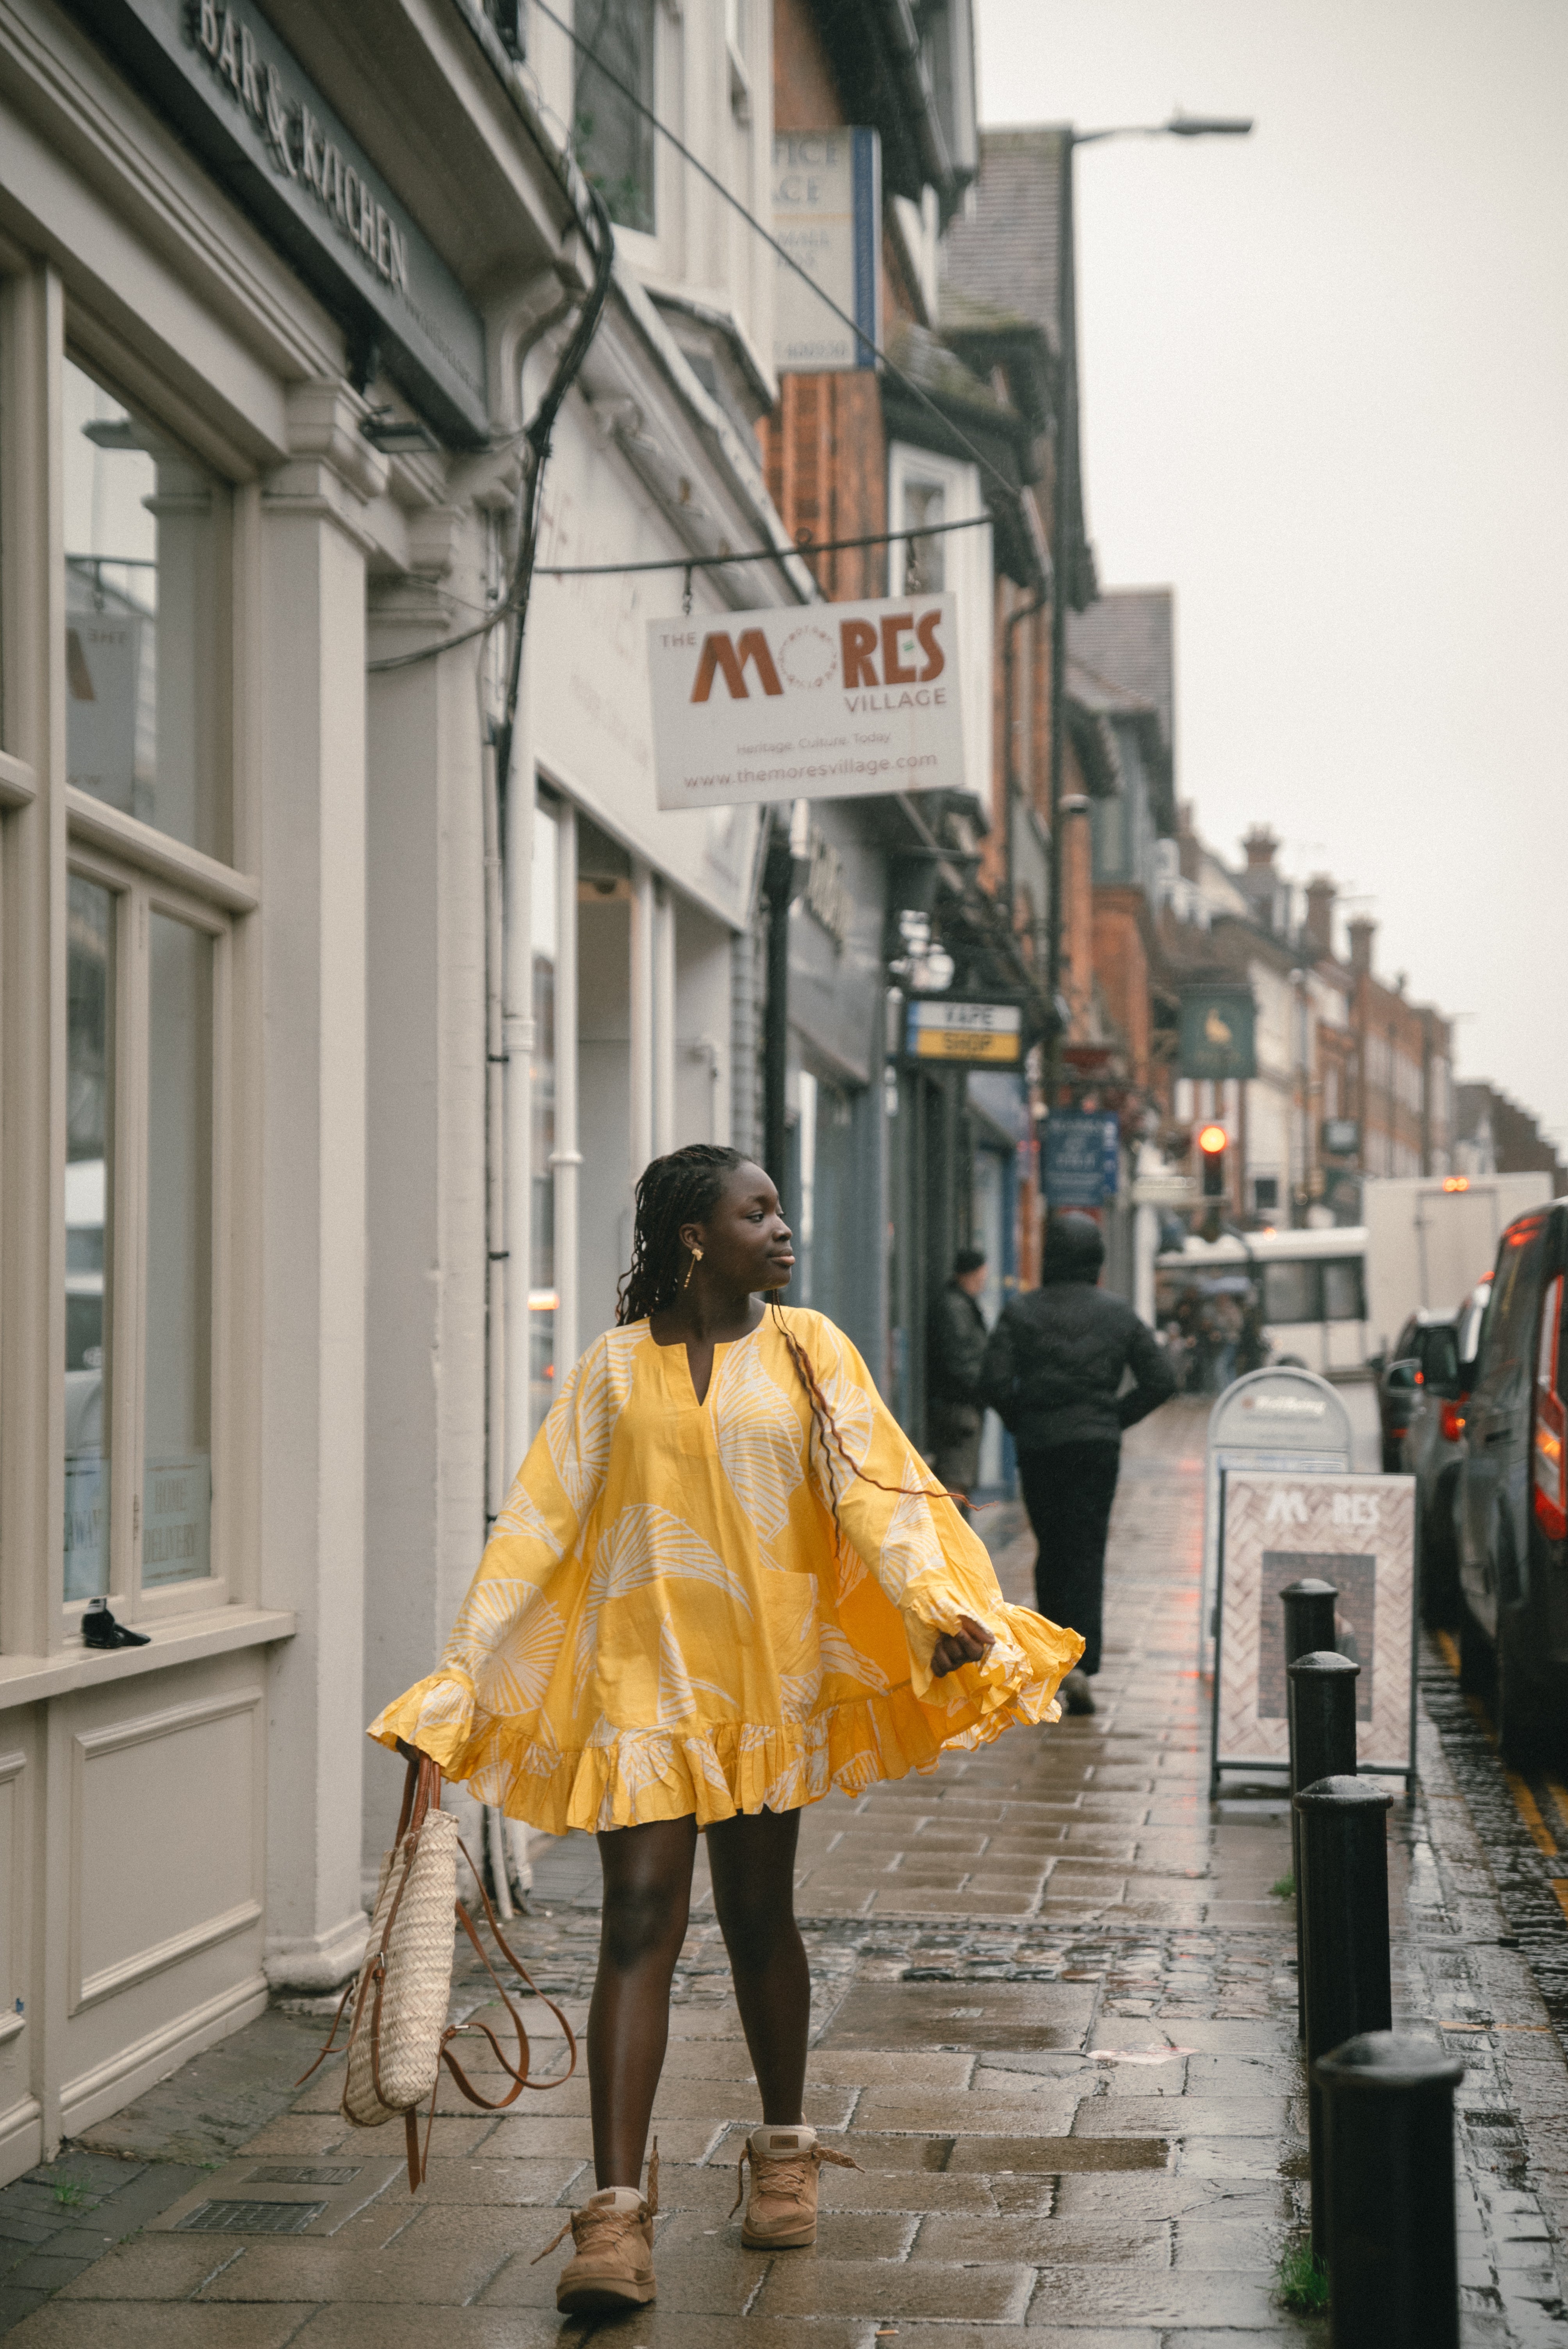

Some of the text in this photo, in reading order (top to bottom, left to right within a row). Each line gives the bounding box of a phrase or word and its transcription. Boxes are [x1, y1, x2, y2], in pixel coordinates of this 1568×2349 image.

[659, 631, 696, 649] THE
[691, 609, 945, 702] MORES
[843, 687, 947, 713] VILLAGE
[683, 753, 938, 788] www.themoresvillage.com
[155, 1478, 188, 1514] HOME
[143, 1522, 198, 1564] DELIVERY
